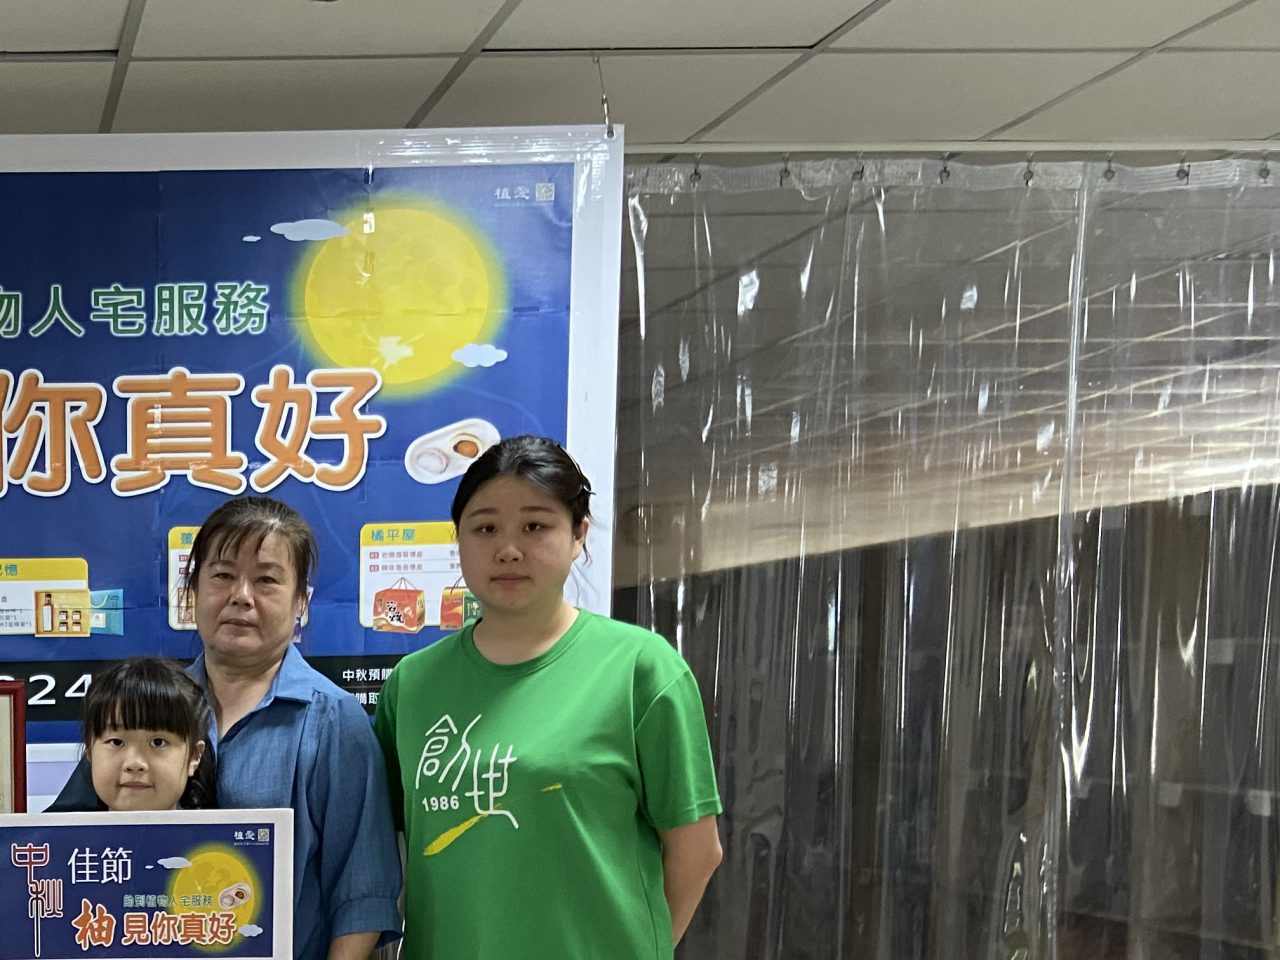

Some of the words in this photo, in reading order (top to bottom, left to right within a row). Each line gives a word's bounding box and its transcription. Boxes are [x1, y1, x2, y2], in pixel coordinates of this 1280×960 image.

[422, 796, 460, 811] 1986
[67, 847, 133, 885] 佳節
[10, 842, 64, 958] 中秋
[71, 898, 237, 952] 柚見你真好
